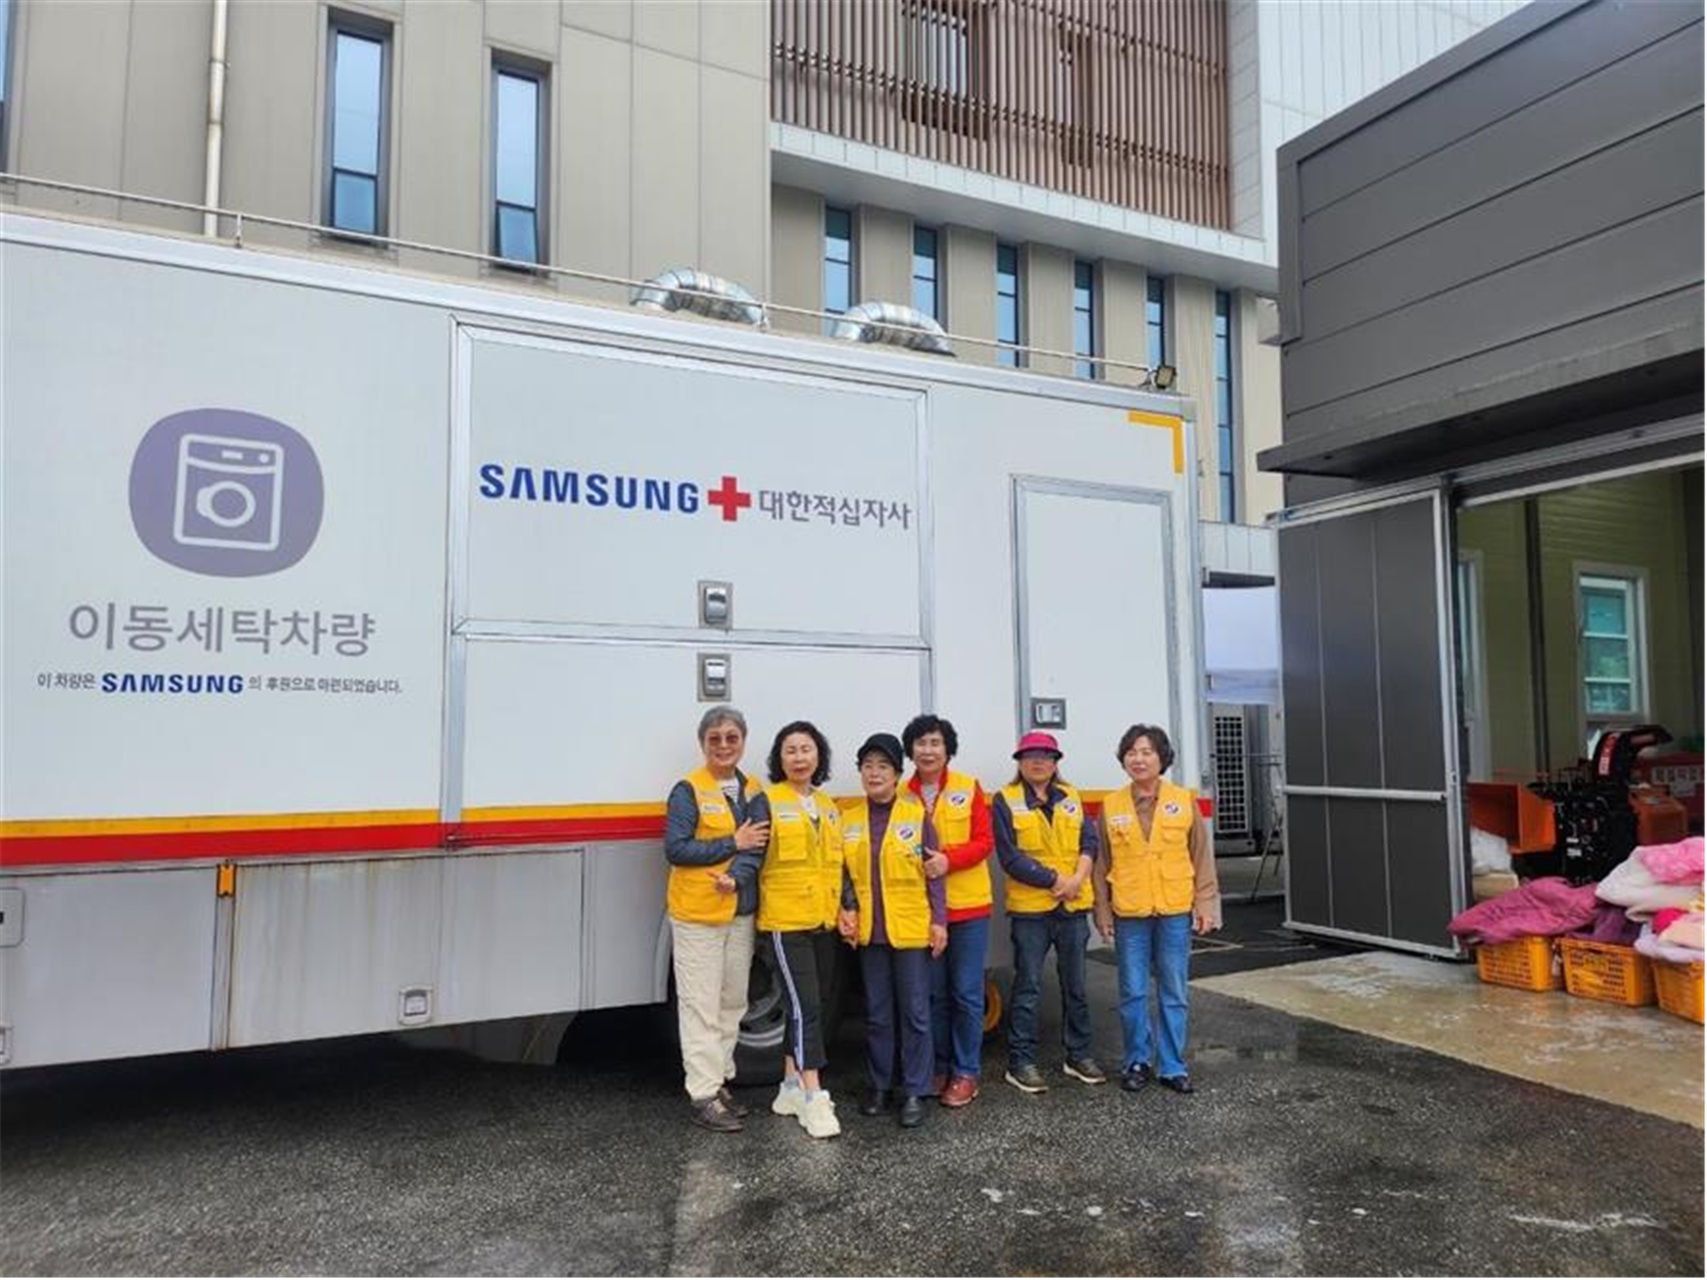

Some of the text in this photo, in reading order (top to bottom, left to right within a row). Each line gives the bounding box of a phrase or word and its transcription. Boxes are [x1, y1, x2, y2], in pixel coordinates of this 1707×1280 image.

[479, 463, 912, 529] SAMSUNG 대한적십자사
[69, 602, 376, 657] 이동세탁차량
[37, 672, 51, 689] 이
[54, 672, 96, 689] 차량은
[102, 672, 243, 693] SAMSUNG
[248, 675, 262, 691] 의
[266, 676, 316, 691] 후원으로
